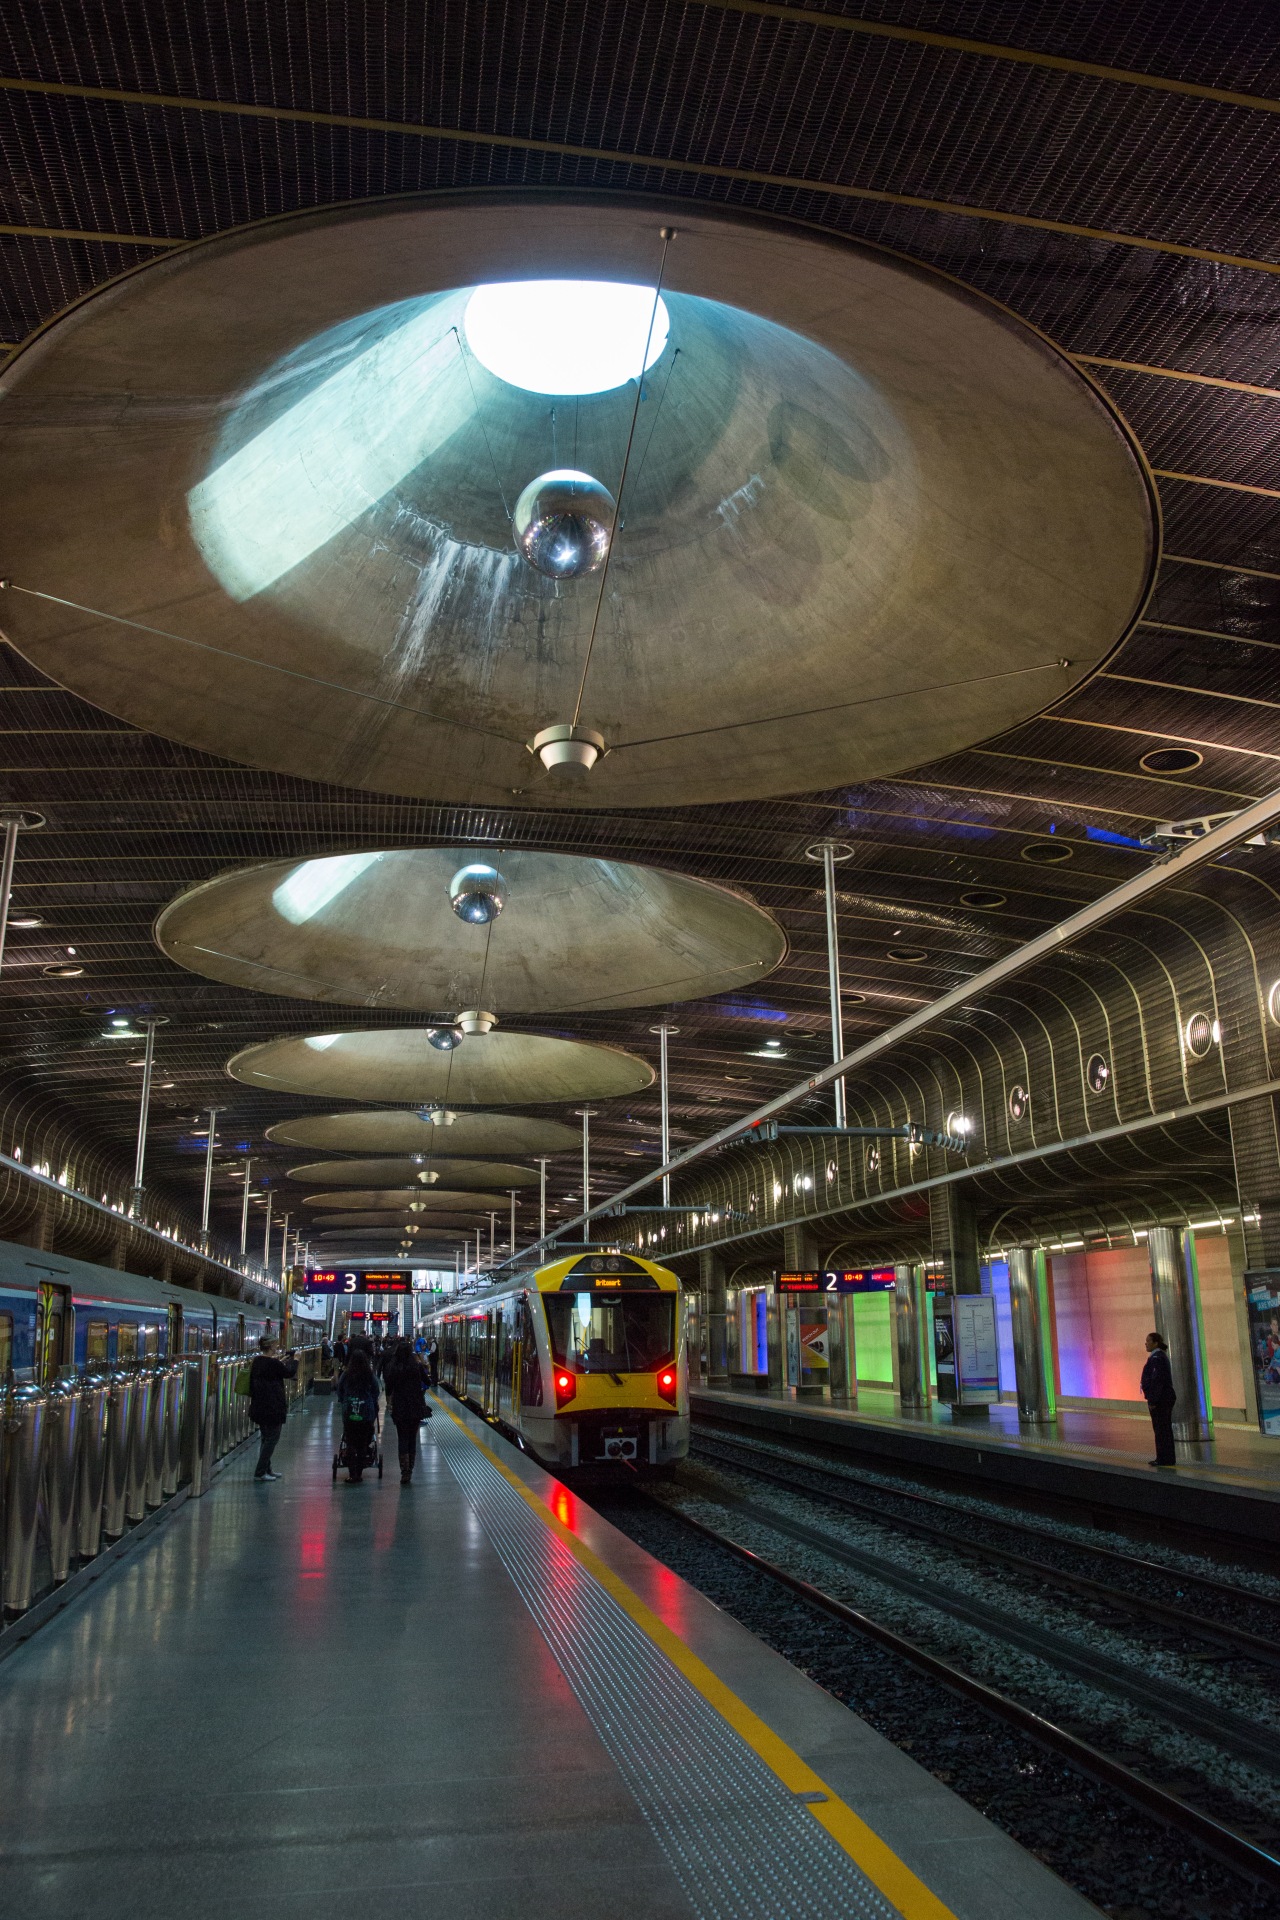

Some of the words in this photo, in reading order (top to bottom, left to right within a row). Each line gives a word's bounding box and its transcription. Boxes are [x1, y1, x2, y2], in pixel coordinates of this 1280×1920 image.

[343, 1273, 357, 1293] 3
[826, 1272, 837, 1291] 2
[365, 1312, 371, 1321] 3
